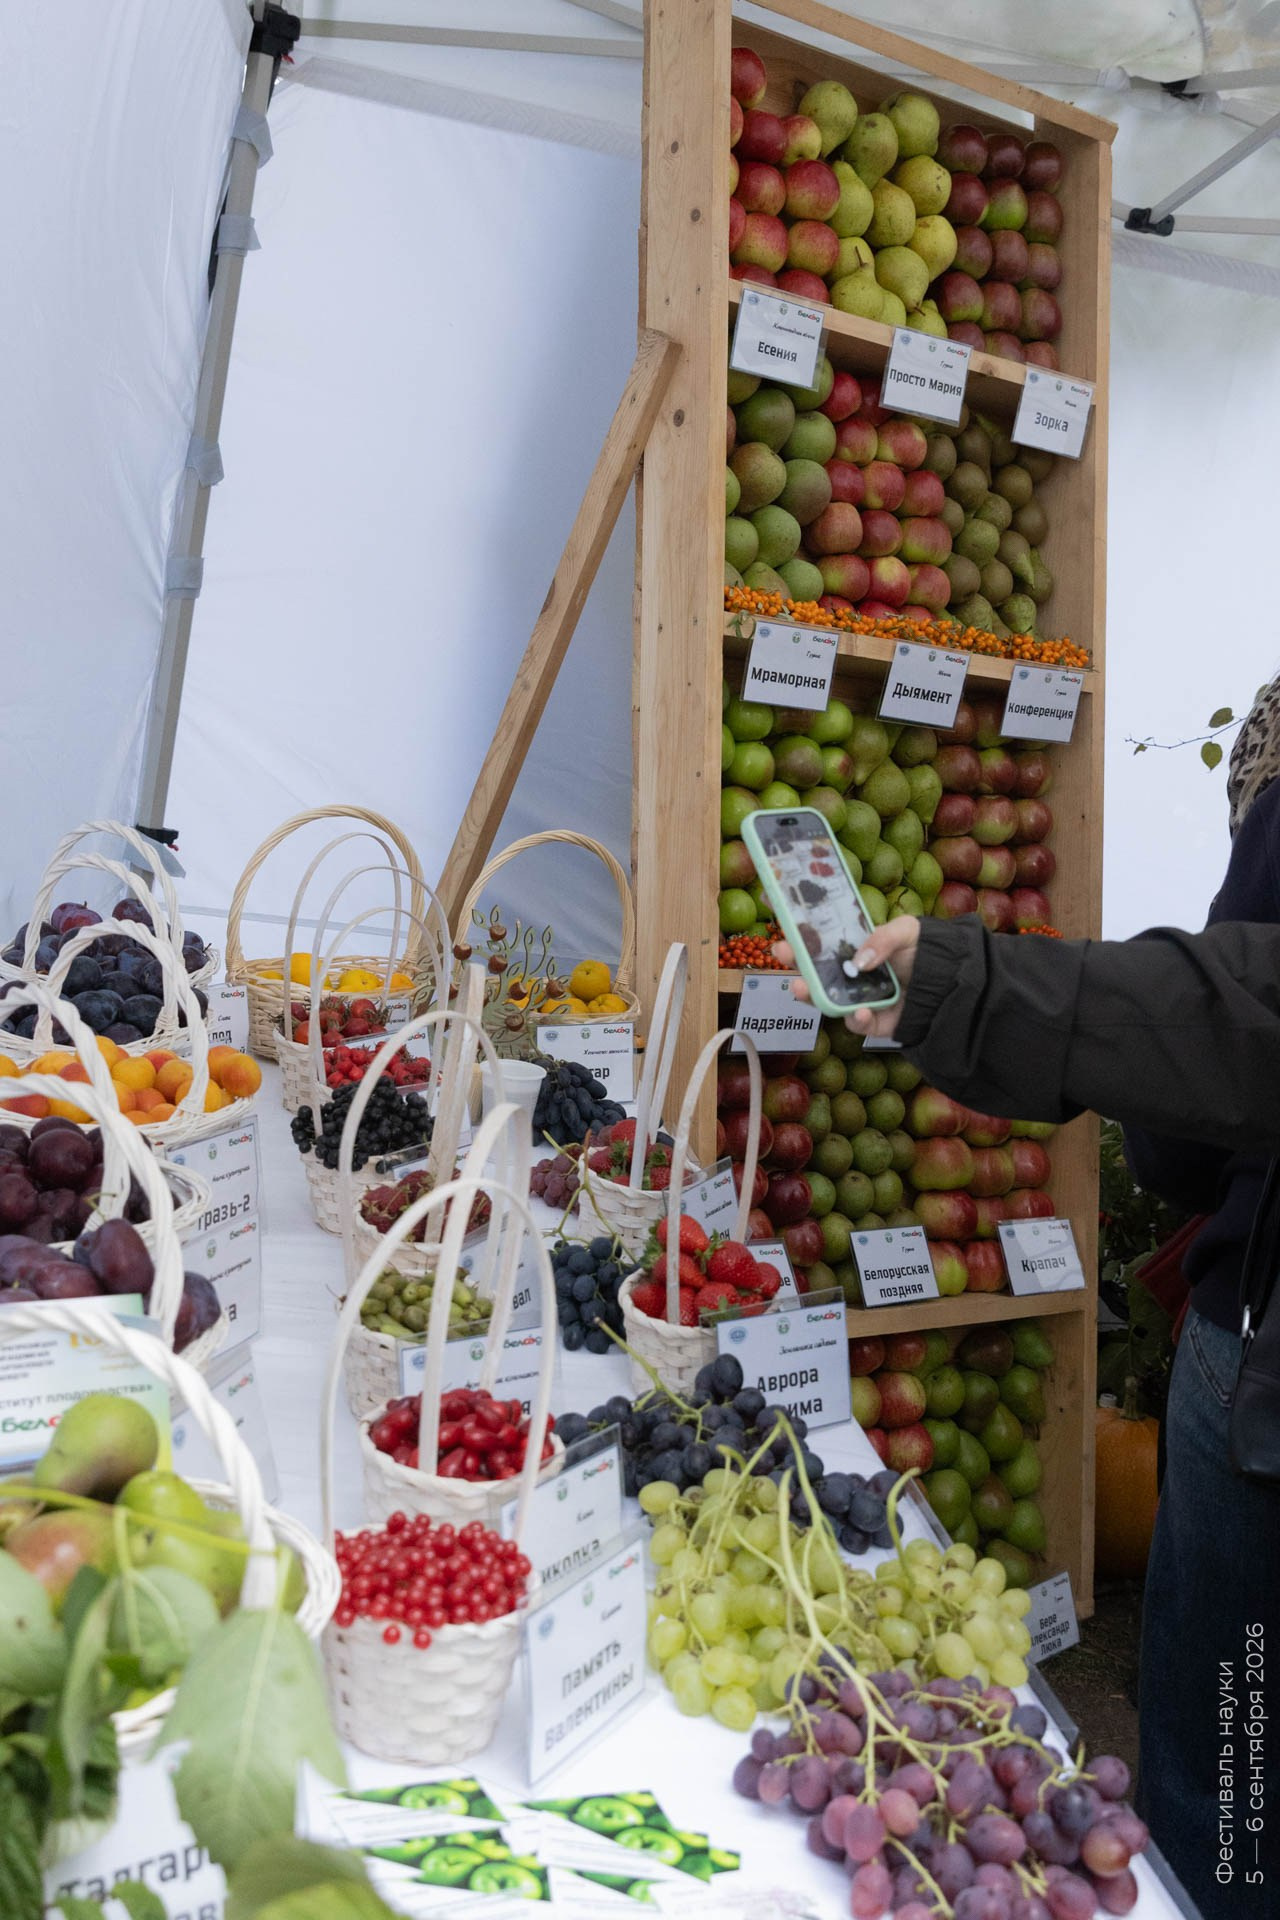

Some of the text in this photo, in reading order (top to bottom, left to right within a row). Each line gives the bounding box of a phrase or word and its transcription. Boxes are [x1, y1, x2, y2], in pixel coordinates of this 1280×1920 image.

[758, 341, 798, 362] Есения
[889, 368, 963, 396] Просто Мария
[1034, 411, 1069, 432] Зорка
[750, 666, 826, 690] Мраморная
[891, 682, 953, 705] Дыямент
[1007, 701, 1074, 721] Конференция
[741, 1015, 814, 1033] Надзейны
[864, 1264, 930, 1281] Белорусская
[1021, 1256, 1067, 1273] Крапач
[880, 1283, 924, 1299] поздняя
[757, 1367, 819, 1393] Аврора
[787, 1397, 823, 1418] има
[1039, 1613, 1057, 1630] Бере
[1040, 1637, 1062, 1656] Люка
[561, 1639, 622, 1700] Память
[544, 1662, 634, 1754] Валентины
